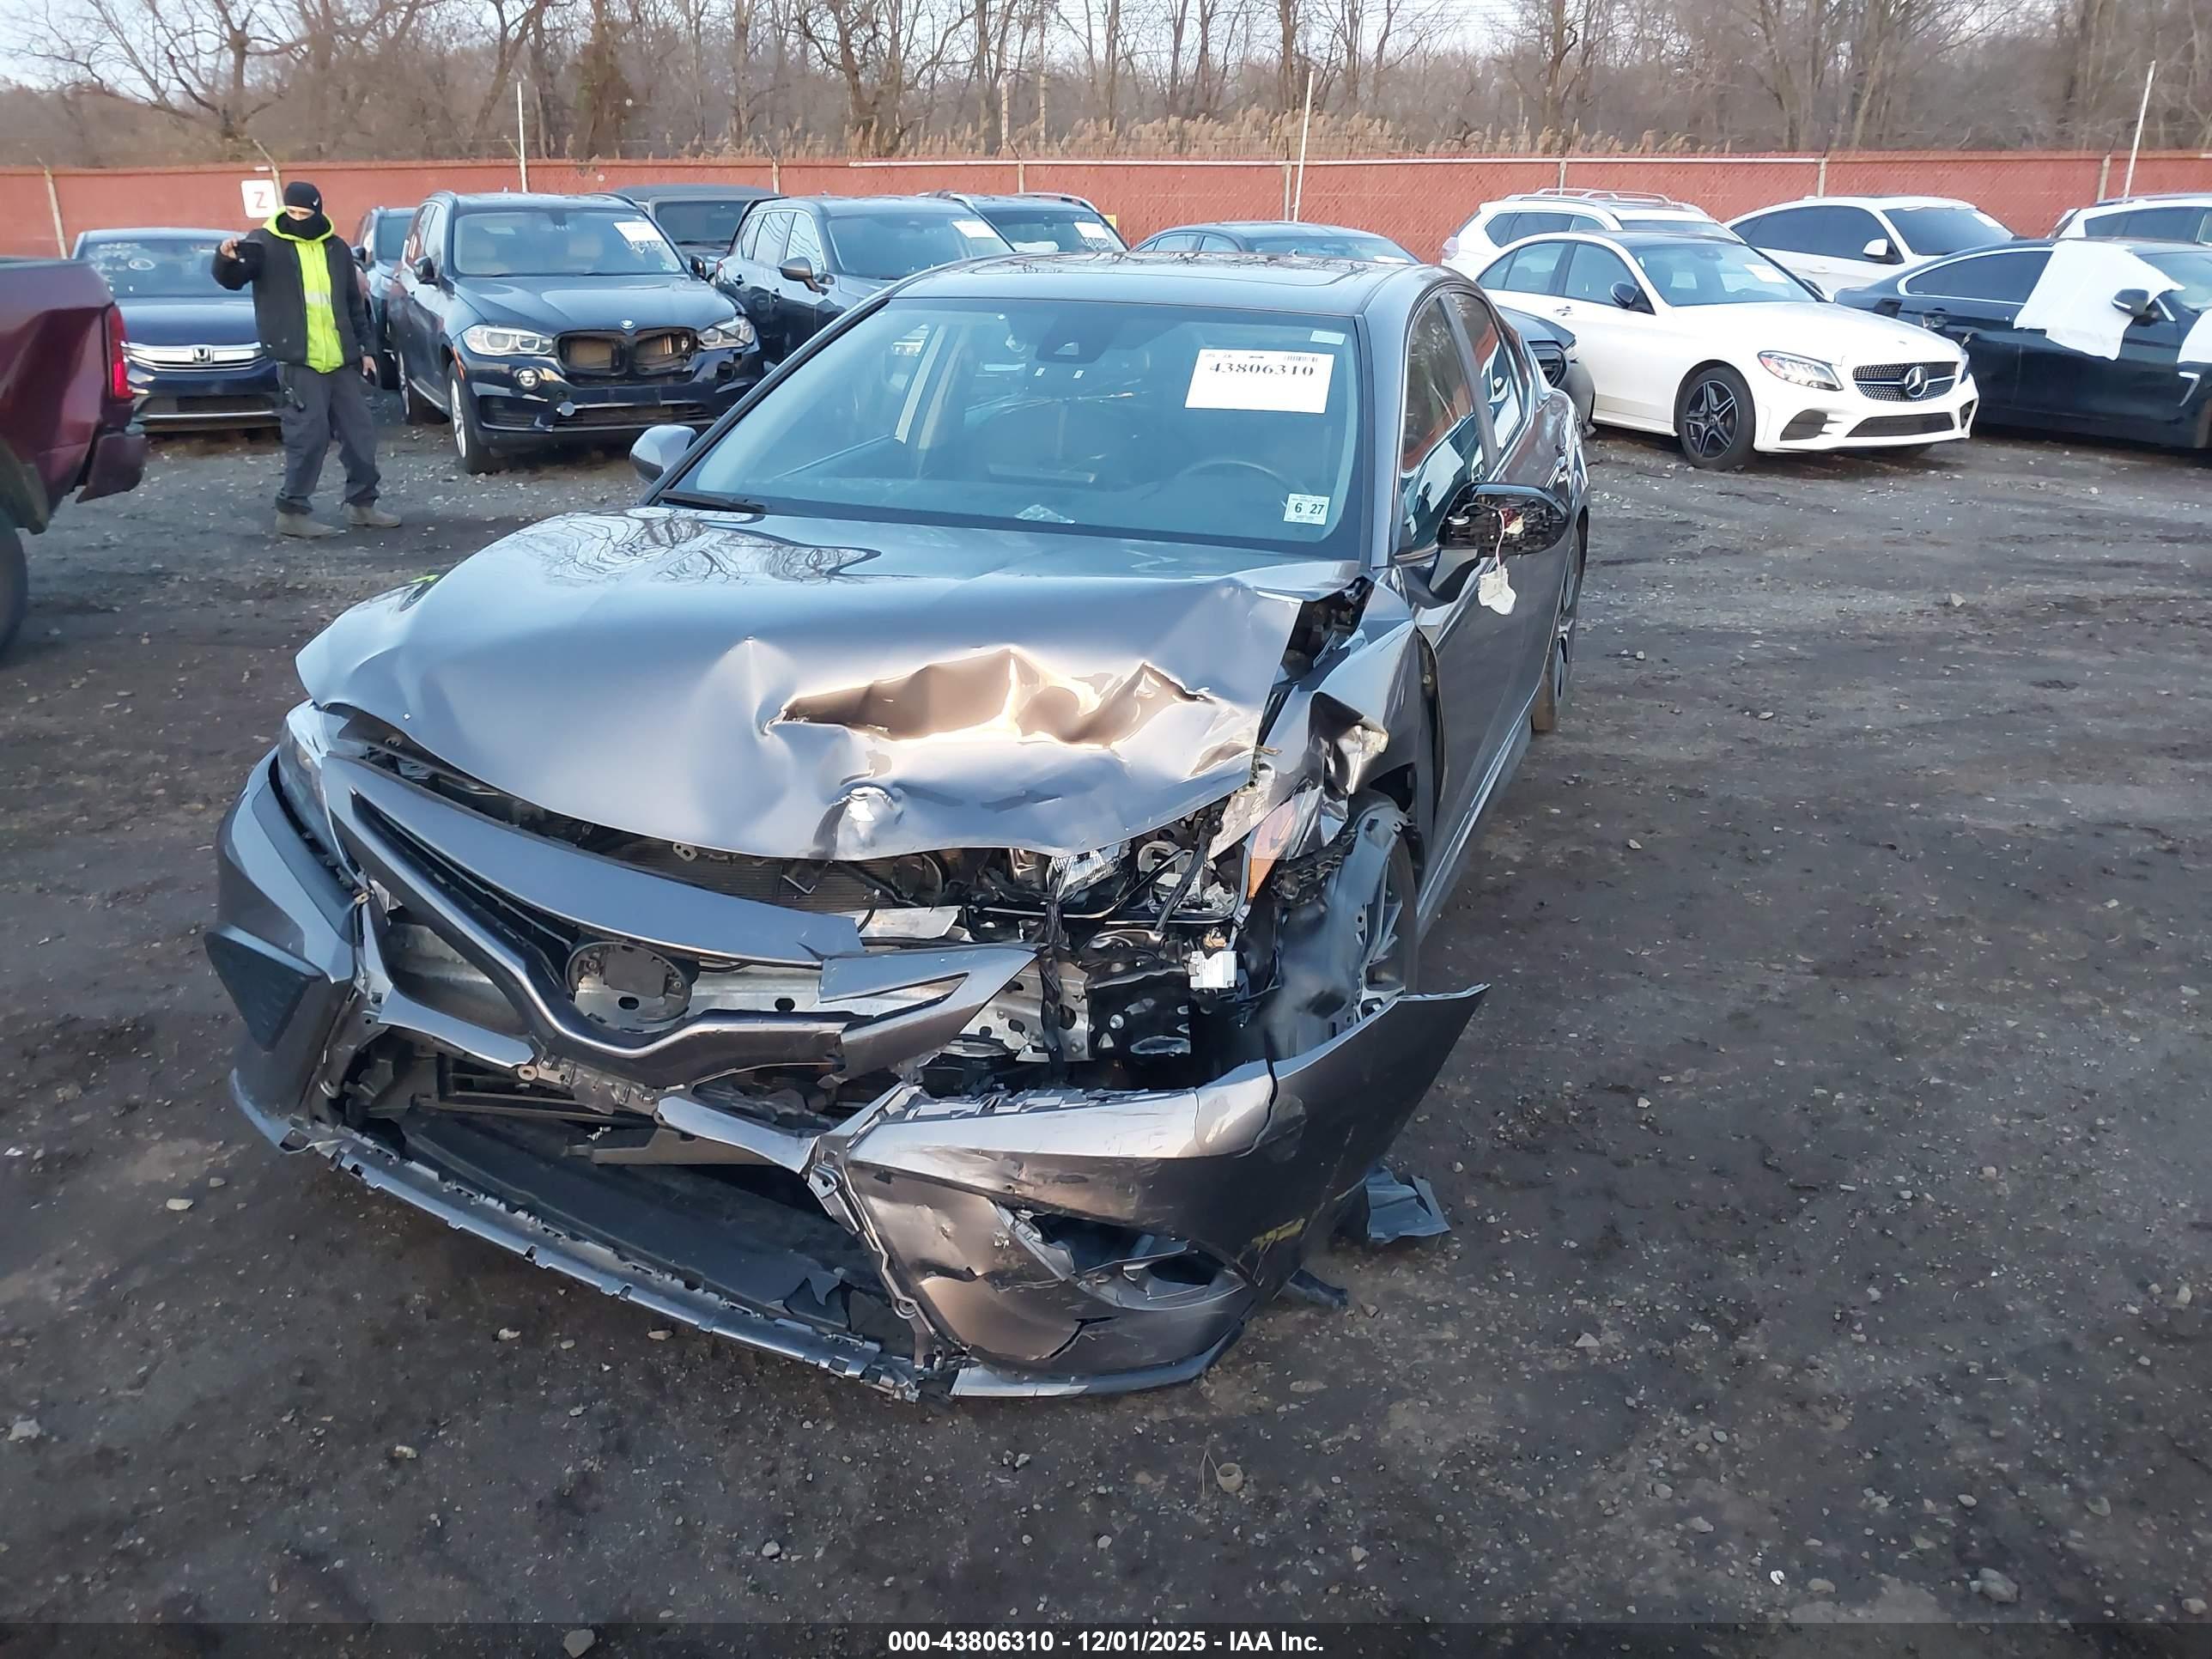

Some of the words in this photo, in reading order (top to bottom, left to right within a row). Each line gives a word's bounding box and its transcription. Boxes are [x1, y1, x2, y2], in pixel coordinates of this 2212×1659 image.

[253, 191, 268, 209] Z
[1209, 362, 1315, 376] 43806310
[1294, 502, 1303, 514] 6
[1310, 503, 1325, 515] 27
